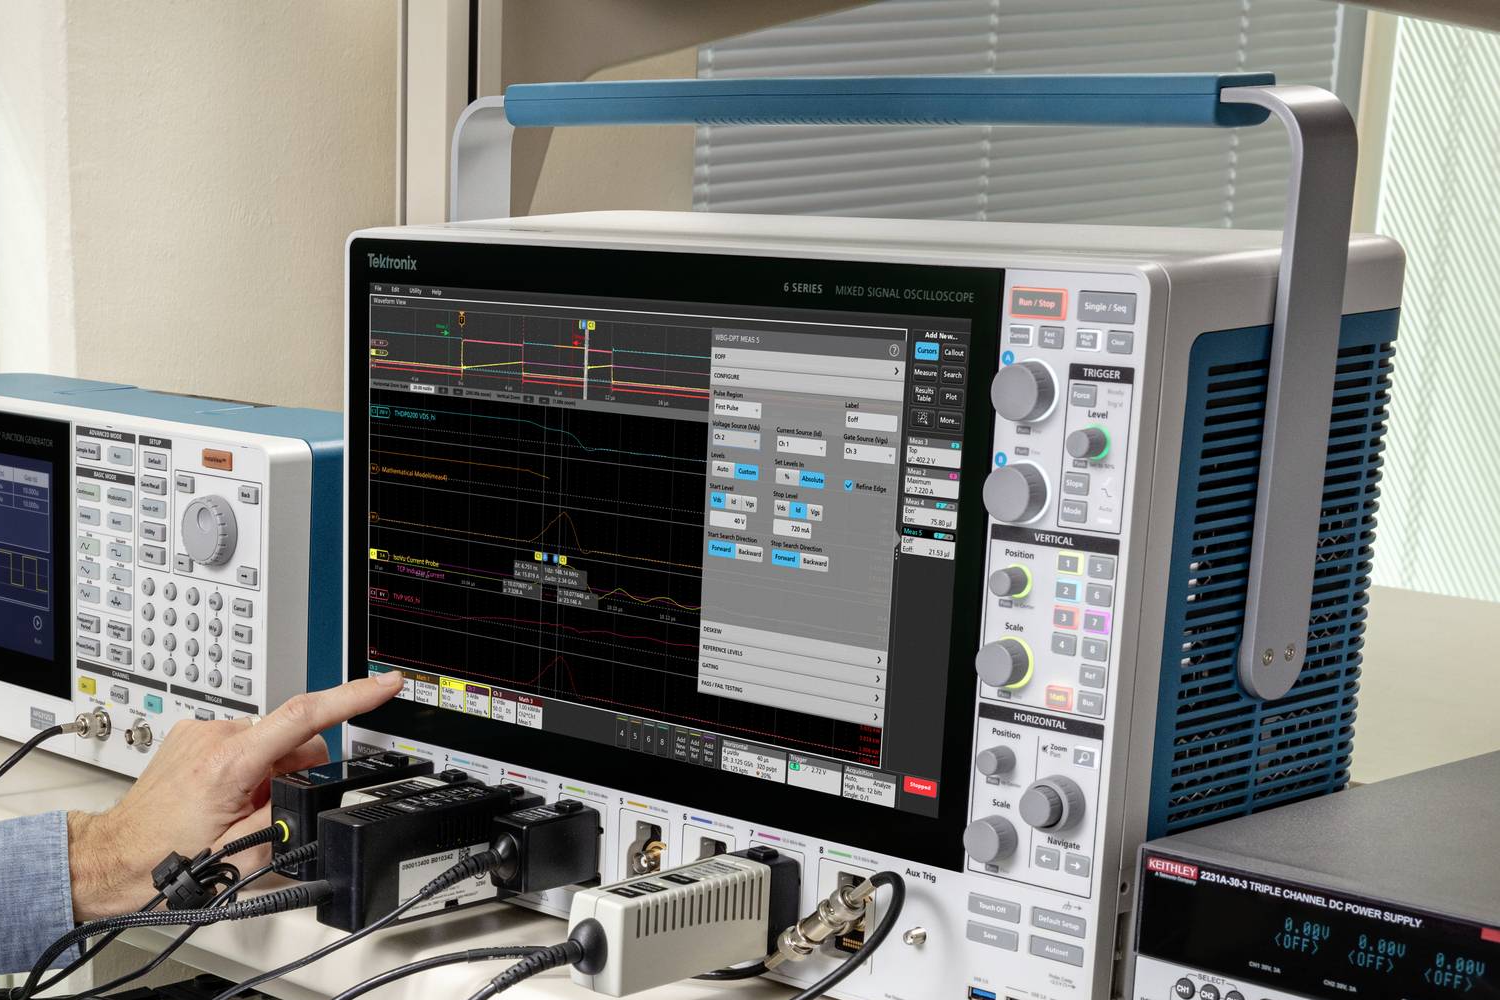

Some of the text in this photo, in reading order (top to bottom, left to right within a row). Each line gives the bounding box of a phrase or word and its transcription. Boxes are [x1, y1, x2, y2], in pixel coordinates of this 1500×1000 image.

[368, 253, 417, 271] Tektronix
[784, 282, 822, 294] 6 SERIES
[836, 285, 974, 302] MIXED SIGNAL OSCILLOSCOPE
[1019, 298, 1056, 309] Run Stop
[1084, 302, 1127, 314] Single Seq
[1083, 368, 1121, 379] TRIGGER
[1073, 391, 1090, 399] Force
[847, 415, 859, 423] Eoff
[1088, 410, 1108, 419] Level
[713, 421, 730, 429] Voltage
[89, 429, 122, 440] ADVANCED MODE
[916, 456, 930, 464] 402.2
[738, 468, 756, 476] Custom
[802, 476, 823, 484] Absolute
[1066, 479, 1083, 489] Slope
[1063, 507, 1082, 516] Mode
[1034, 533, 1074, 546] VERTICAL
[738, 549, 761, 557] Backward
[1005, 548, 1034, 560] Position
[775, 554, 827, 567] Forward Backward
[1094, 591, 1100, 599] 6
[1005, 622, 1024, 632] Scale
[703, 645, 726, 654] REFERENCE
[1090, 646, 1096, 654] 8
[1085, 671, 1096, 680] Ref
[1082, 699, 1094, 707] Bus
[1014, 712, 1067, 730] HORIZONTAL
[992, 727, 1021, 740] Position
[1050, 743, 1067, 753] Zoom
[790, 754, 808, 764] Trigger
[844, 782, 856, 791] High
[873, 780, 892, 790] Analyze
[910, 781, 932, 792] Stopped
[992, 799, 1011, 810] Scale
[1047, 836, 1081, 852] Navigate
[1149, 860, 1197, 877] KEITHLEY
[905, 868, 936, 883] Aux Trig
[1200, 871, 1248, 889] 2231A-30-3
[1249, 882, 1281, 897] TRIPLE
[1283, 889, 1327, 908] CHANNEL
[1329, 900, 1344, 910] DC
[1345, 904, 1382, 920] POWER
[1384, 912, 1423, 928] SUPPLY
[979, 902, 1006, 914] Touch Off
[1038, 914, 1080, 931] Default Setup
[983, 931, 998, 941] Save
[1045, 945, 1068, 957] Autoset
[1359, 934, 1406, 958] 0.00V
[1436, 953, 1485, 977] 0.00V
[1198, 974, 1226, 985] SELECT
[1176, 984, 1190, 993] CH1
[1201, 990, 1214, 1000] CH2
